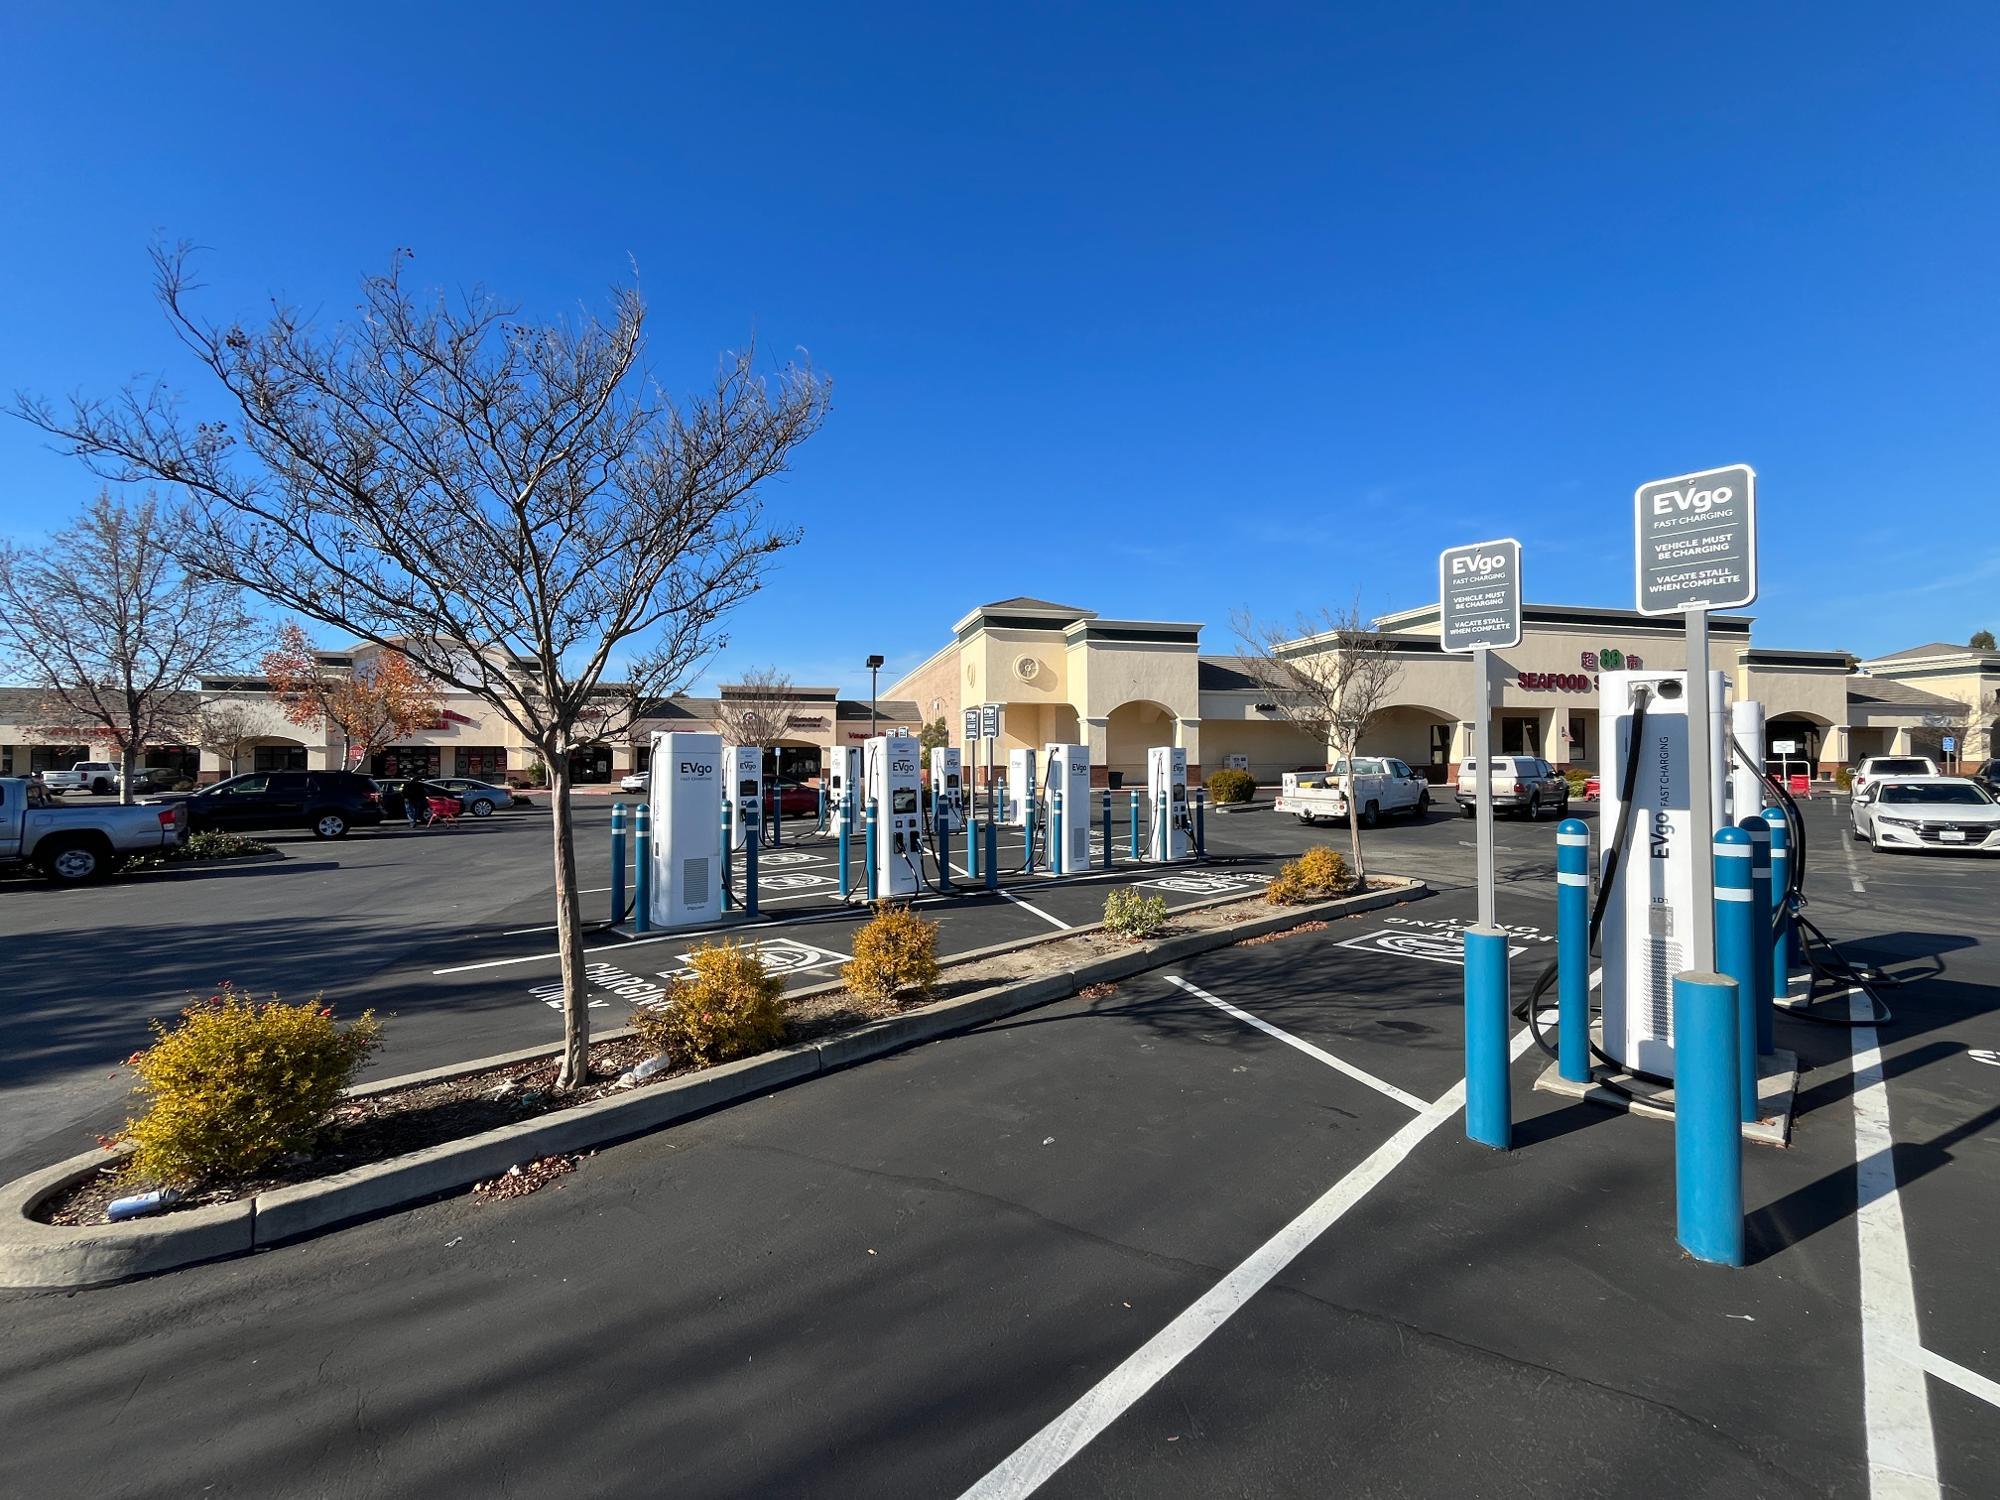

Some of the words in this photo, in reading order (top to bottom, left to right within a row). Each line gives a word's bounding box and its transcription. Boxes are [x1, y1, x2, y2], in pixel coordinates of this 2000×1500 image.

[1653, 486, 1733, 515] EVgo
[1654, 518, 1678, 529] FAST
[1679, 509, 1733, 525] CHARGING
[1654, 539, 1698, 552] VEHICLE
[1702, 533, 1733, 545] MUST
[1658, 552, 1671, 560] BE
[1672, 542, 1730, 559] CHARGING
[1452, 554, 1506, 575] EVgo
[1453, 577, 1469, 585] FAST
[1470, 572, 1506, 583] CHARGING
[1649, 582, 1680, 593] WHEN
[1681, 575, 1740, 589] COMPLETE
[1656, 571, 1697, 584] VACATE
[1699, 567, 1732, 579] STALL
[1453, 593, 1483, 603] VEHICLE
[1465, 598, 1504, 609] CHARGING
[1450, 627, 1471, 635] WHEN
[1472, 623, 1511, 633] COMPLETE
[1454, 619, 1482, 628] VACATE
[1483, 617, 1505, 625] STALL
[1518, 672, 1588, 690] SEAFOOD
[681, 762, 713, 776] EVgo
[892, 762, 915, 774] EVgo
[1072, 763, 1087, 773] EVgo
[1660, 736, 1669, 784] CHARGING
[1660, 785, 1669, 807] FAST
[1650, 812, 1675, 859] EVgo
[585, 961, 674, 1013] CHARGIN
